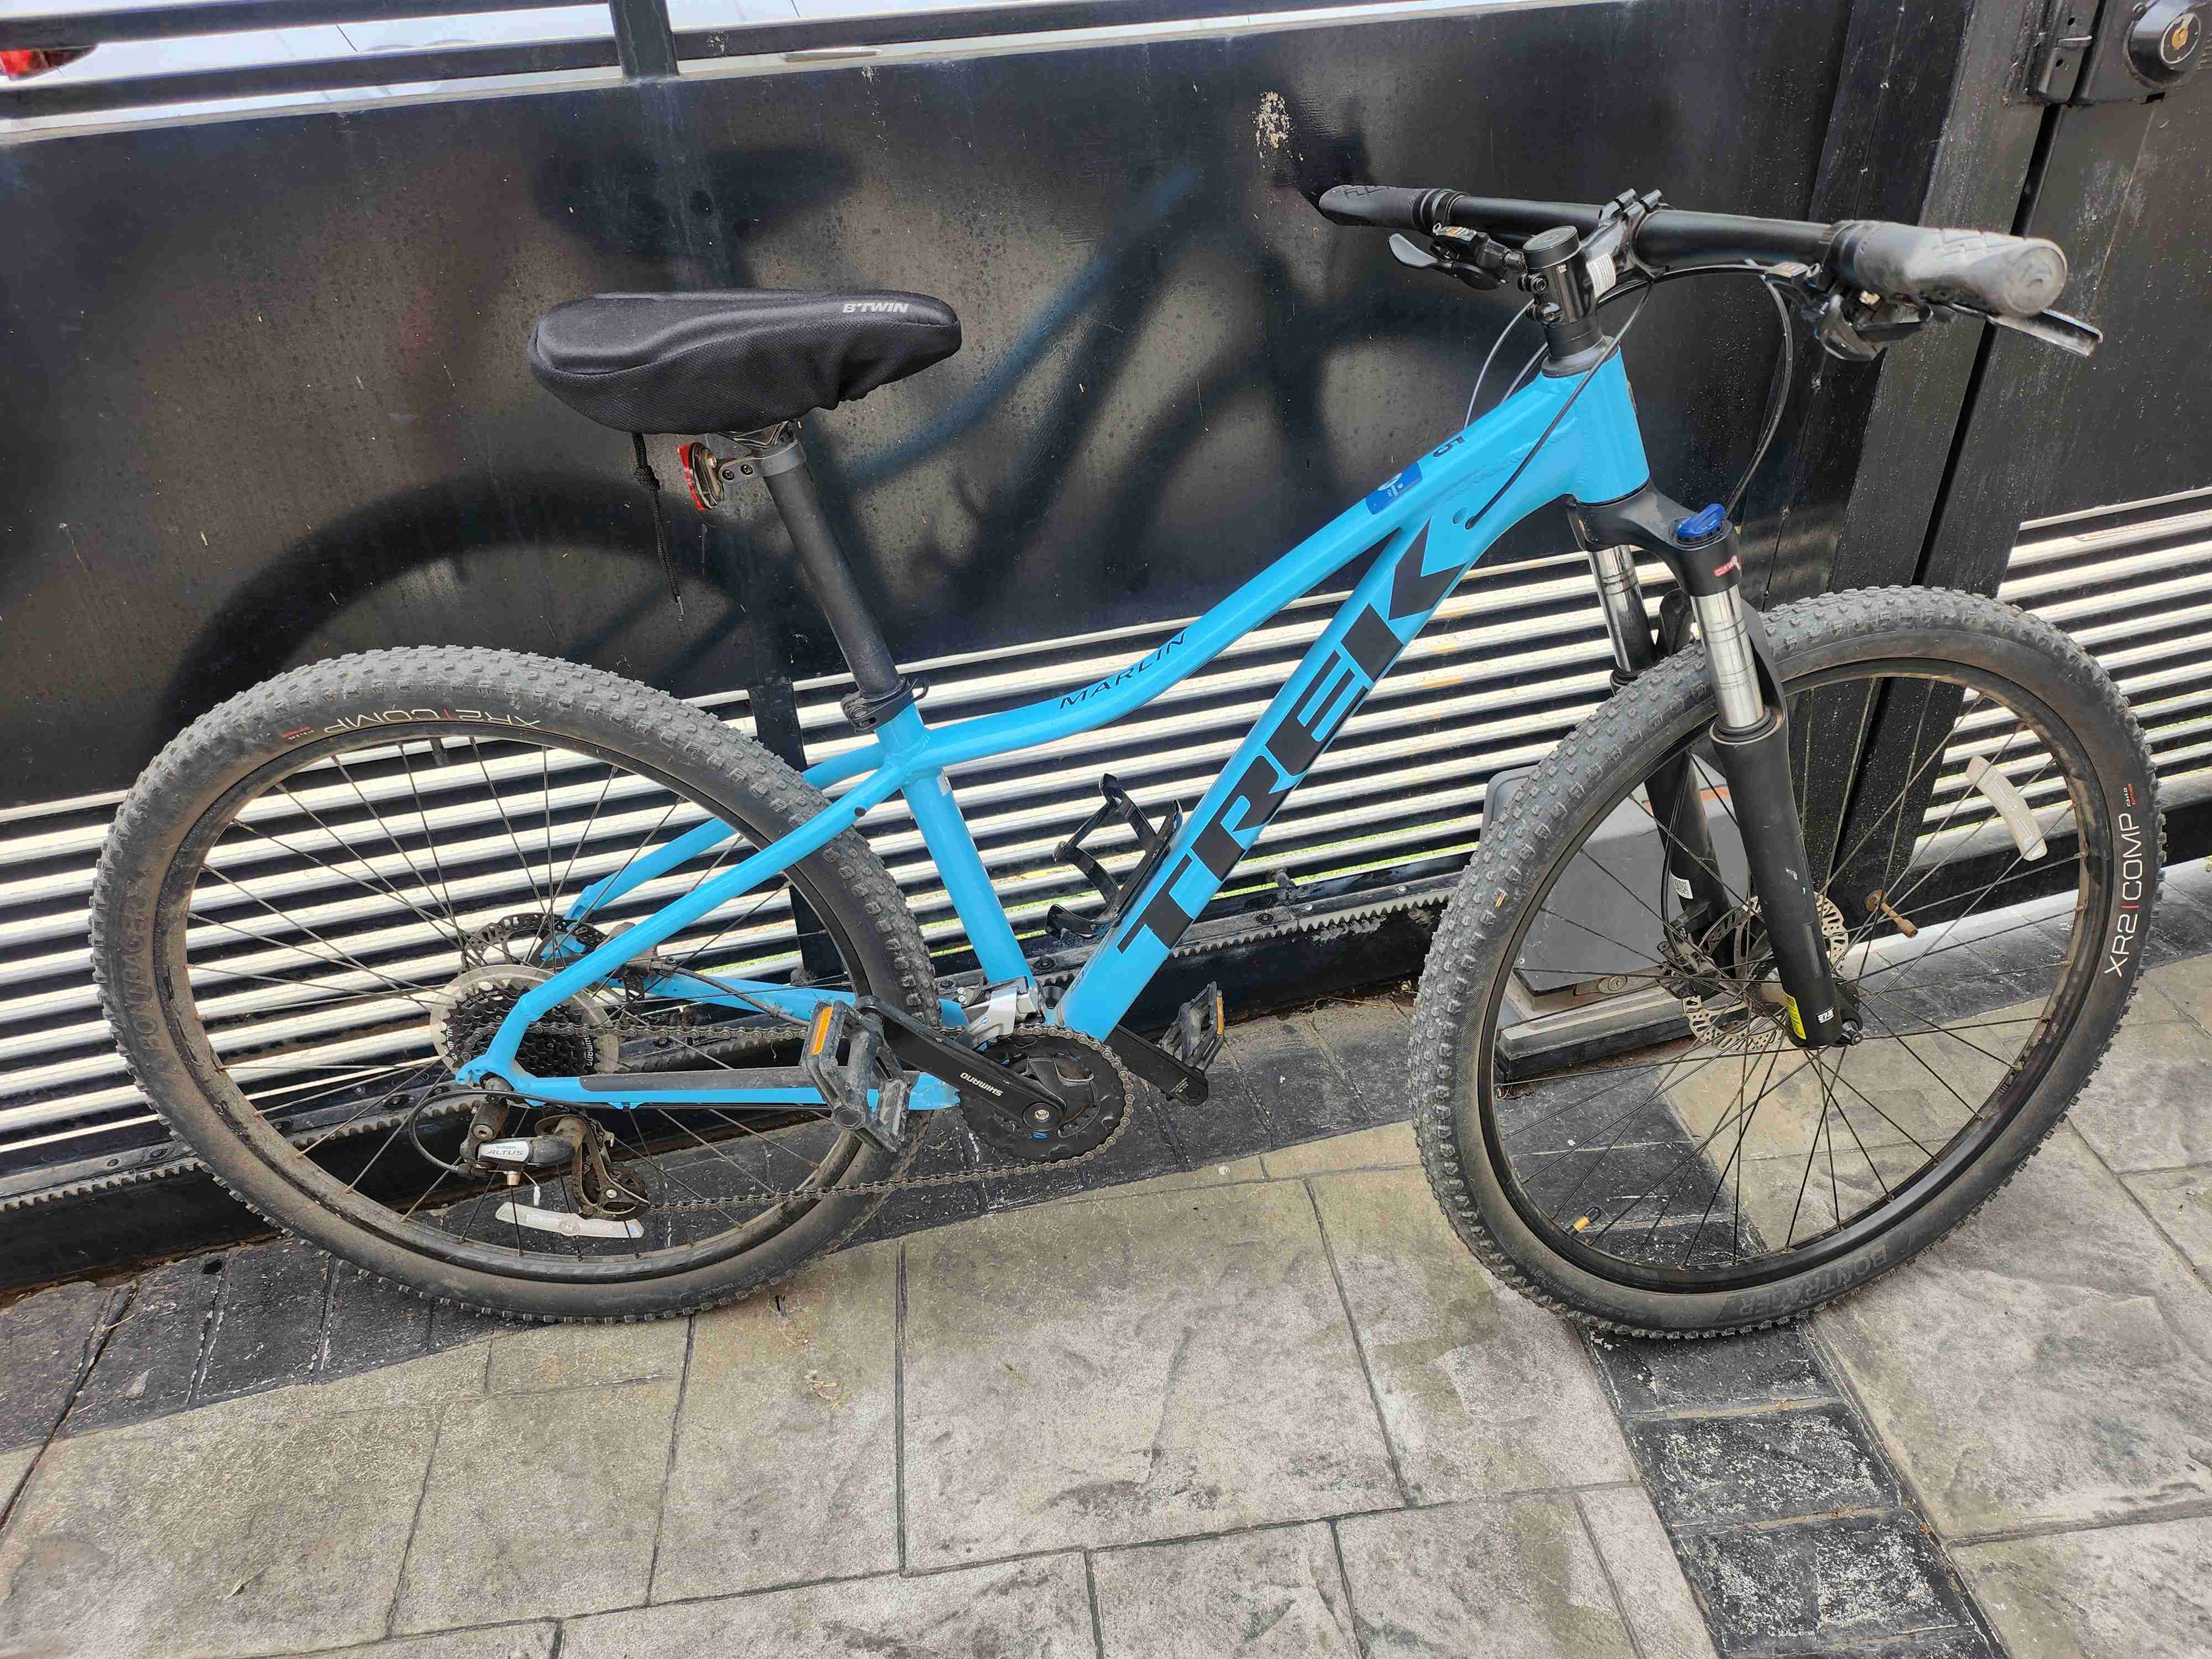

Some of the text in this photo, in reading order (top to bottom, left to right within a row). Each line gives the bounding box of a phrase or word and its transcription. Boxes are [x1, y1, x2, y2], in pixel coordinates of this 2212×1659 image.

[1060, 632, 1186, 709] MARLIN
[1118, 517, 1469, 954] TREK
[959, 1072, 1004, 1097] SHIMANO
